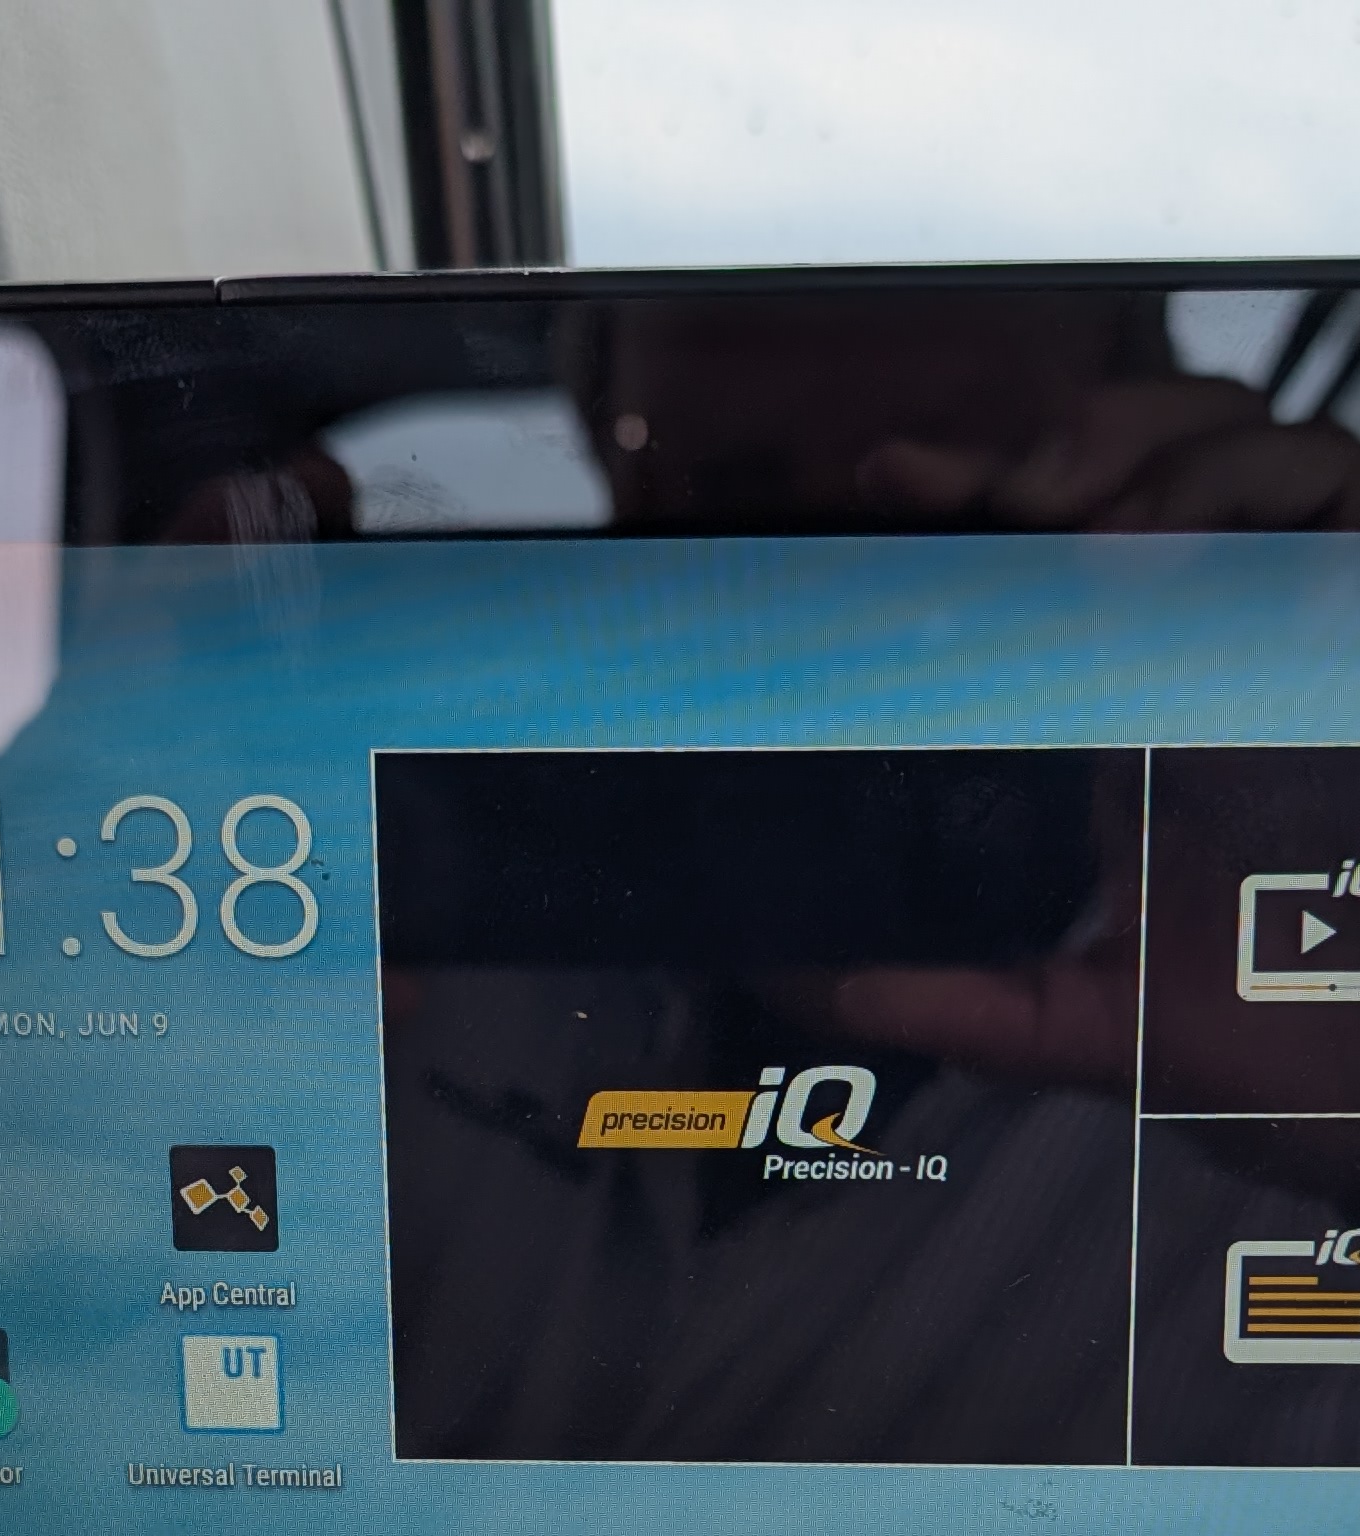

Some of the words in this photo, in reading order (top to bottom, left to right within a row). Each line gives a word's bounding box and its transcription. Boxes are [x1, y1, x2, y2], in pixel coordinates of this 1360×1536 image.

[78, 1011, 140, 1036] JUN
[151, 1011, 169, 1037] 9
[600, 1106, 727, 1137] precision
[762, 1154, 894, 1180] Precision
[916, 1155, 949, 1182] IQ
[160, 1282, 207, 1308] App
[212, 1281, 297, 1307] Central
[221, 1347, 268, 1380] UT
[127, 1462, 235, 1488] Universal
[242, 1463, 344, 1489] Terminal
